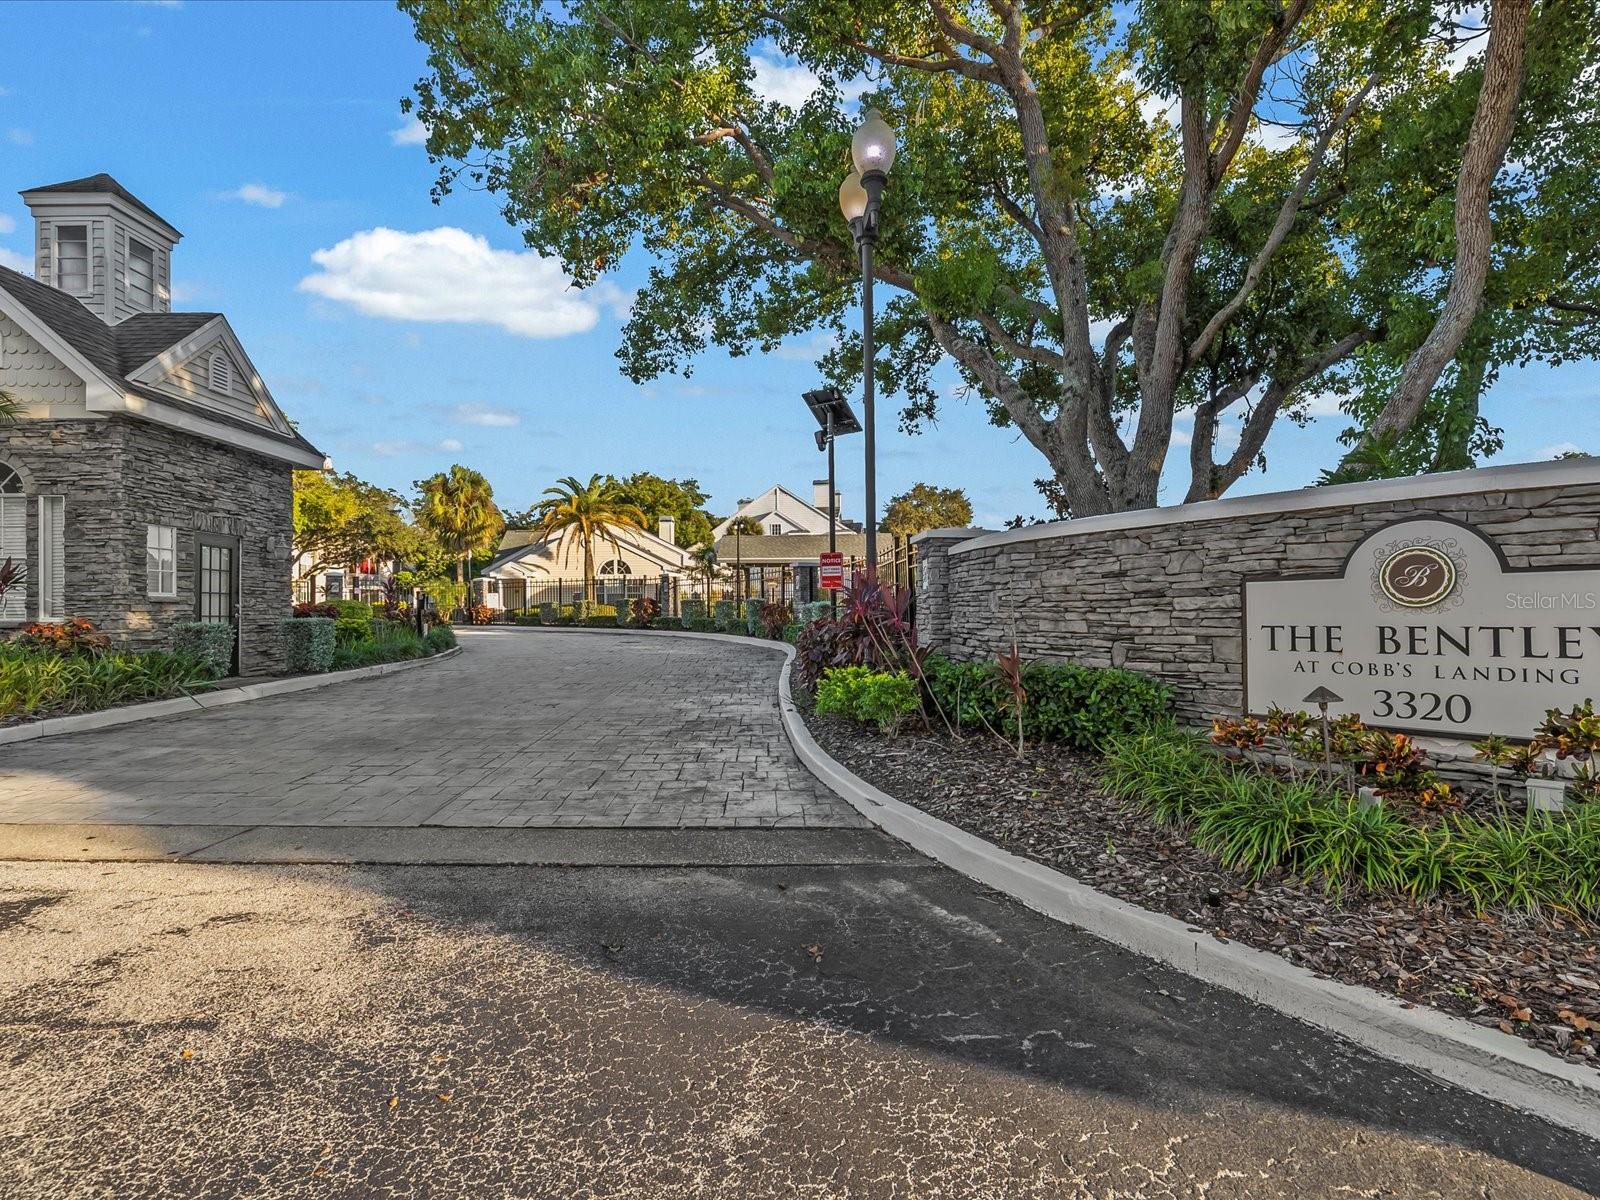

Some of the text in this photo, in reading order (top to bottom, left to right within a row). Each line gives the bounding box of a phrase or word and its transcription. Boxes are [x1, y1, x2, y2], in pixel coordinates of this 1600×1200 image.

[1394, 563, 1439, 588] B
[1261, 625, 1344, 653] THE
[1294, 660, 1580, 685] AT COBB'S LANDING
[1373, 690, 1472, 724] 3320
